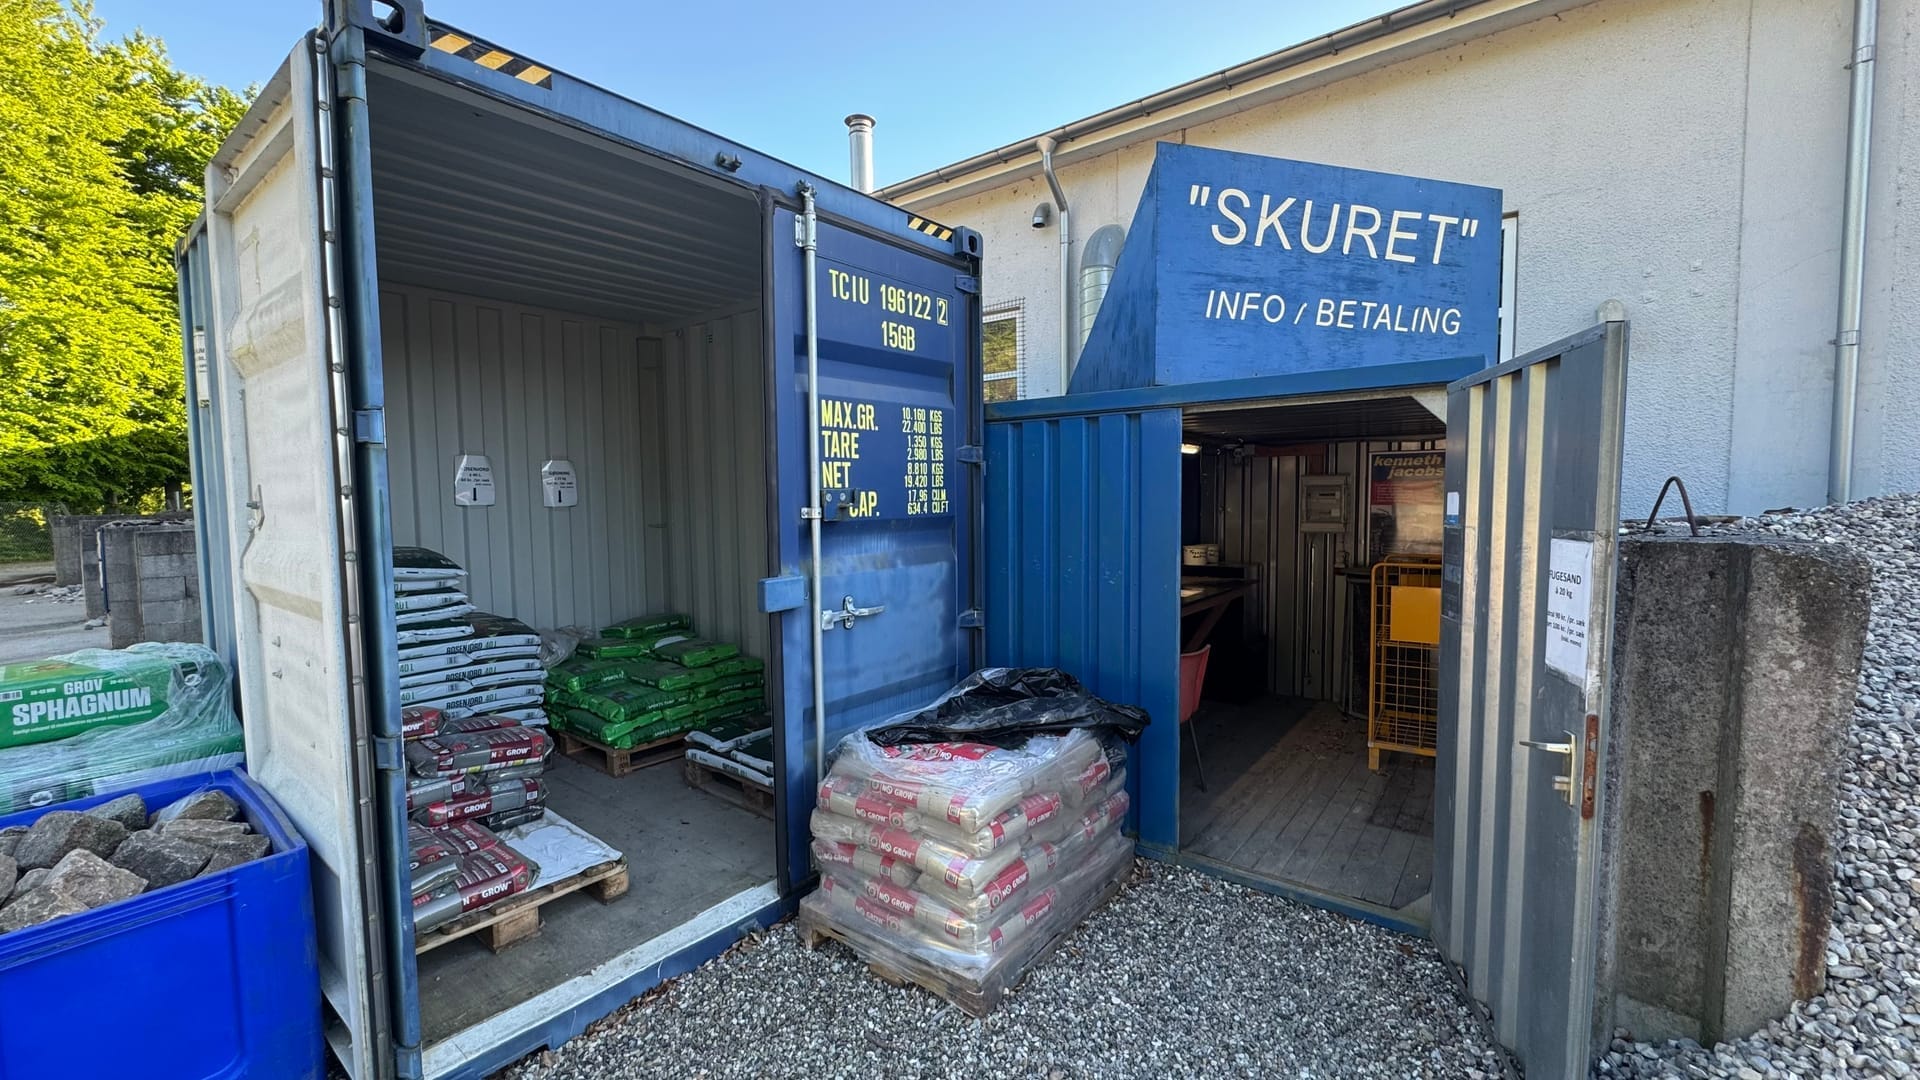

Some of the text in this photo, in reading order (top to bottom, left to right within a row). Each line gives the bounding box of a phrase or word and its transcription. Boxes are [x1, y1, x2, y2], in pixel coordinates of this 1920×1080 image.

[1189, 184, 1479, 264] "SKURET"
[828, 268, 947, 325] TCIU 196122 2
[1205, 290, 1462, 336] INFO / BETALING
[882, 320, 915, 351] 15GB
[822, 399, 878, 431] MAX.GR.
[902, 407, 942, 422] 10.160 KGS
[902, 420, 942, 434] 22.400 LBS
[822, 430, 860, 459] TARE
[908, 435, 943, 448] 1.350 KGS
[907, 448, 944, 461] 2.980 LBS
[1374, 454, 1442, 466] kenneth
[822, 461, 851, 488] NET
[907, 462, 944, 475] 8.810 KGS
[904, 475, 944, 488] 19.420 LBS
[908, 490, 928, 502] 17.96
[907, 502, 928, 515] 634.4
[64, 678, 103, 695] GROV
[12, 686, 151, 726] SPHAGNUM
